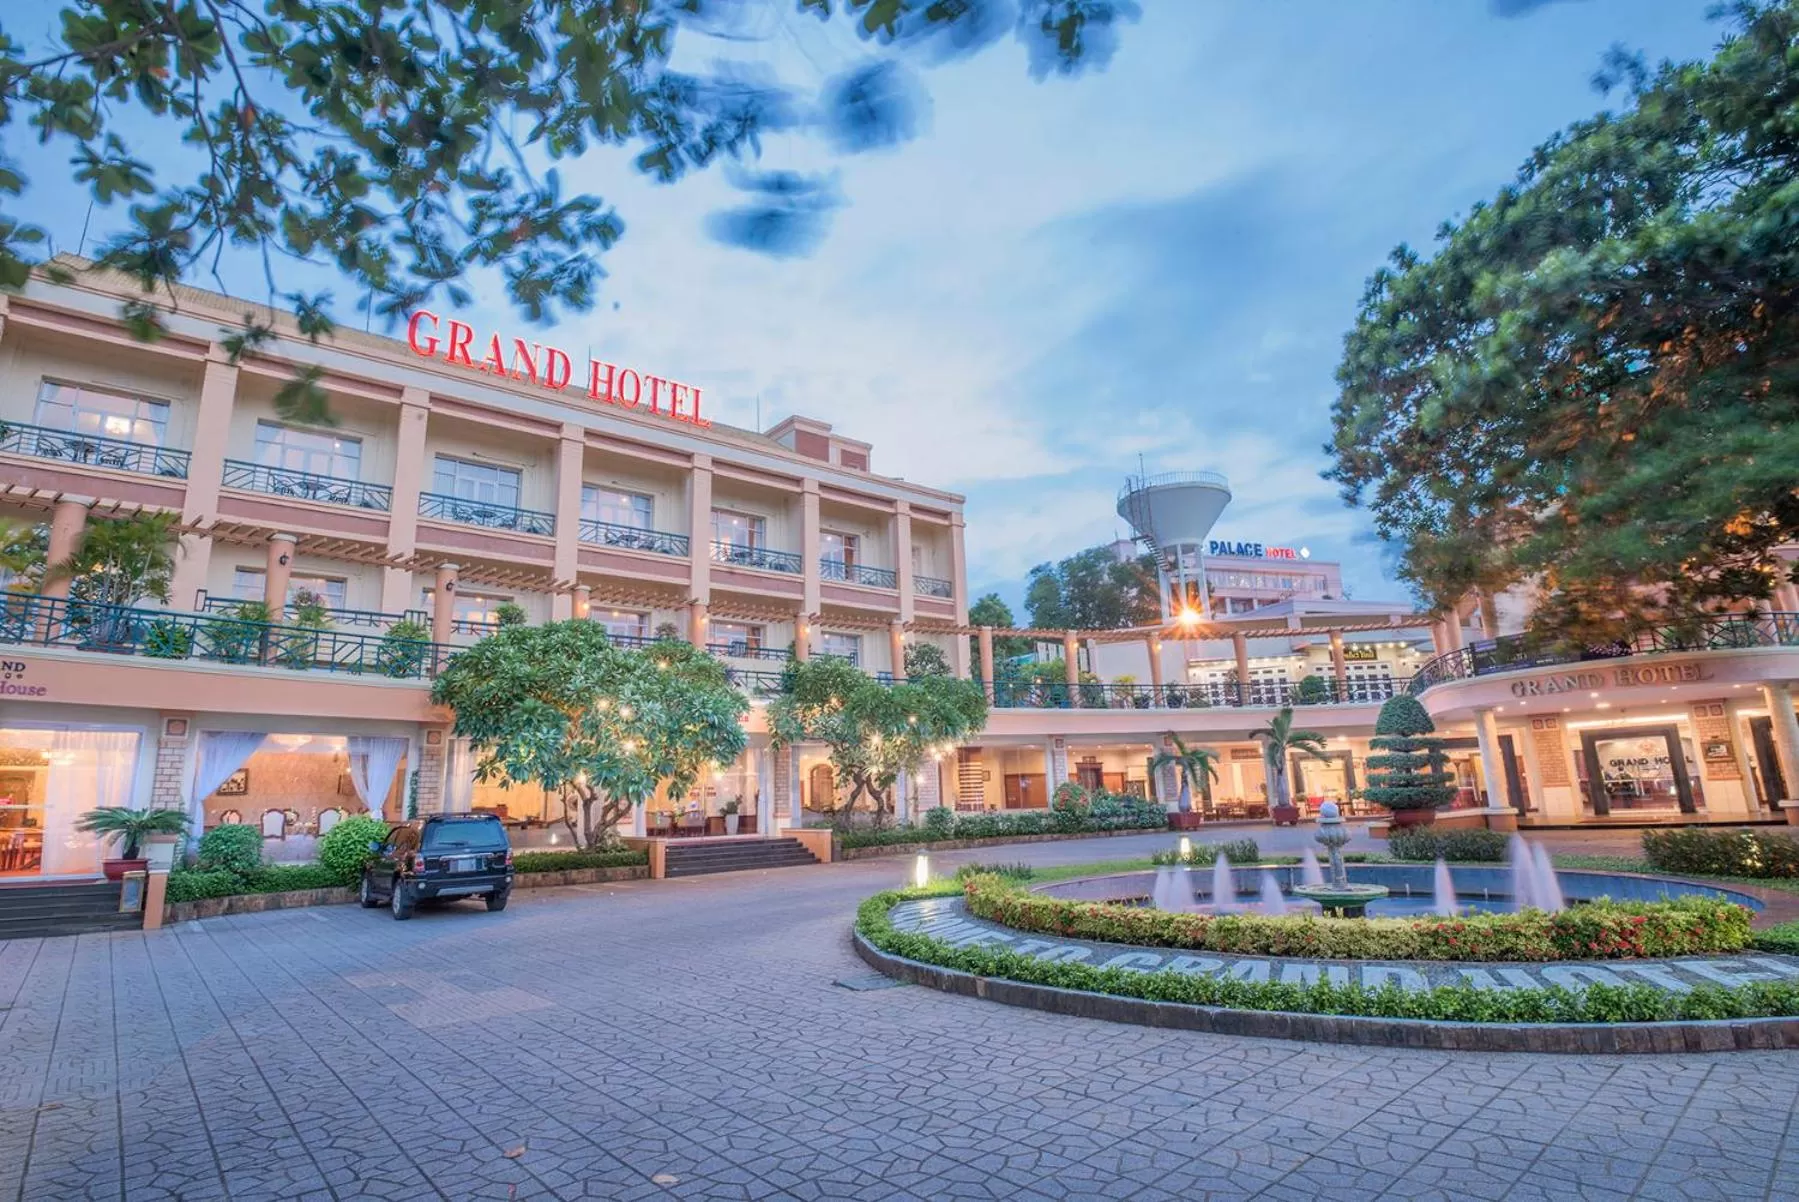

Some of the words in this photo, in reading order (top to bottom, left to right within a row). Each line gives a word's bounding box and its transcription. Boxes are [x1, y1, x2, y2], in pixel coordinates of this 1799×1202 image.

[407, 309, 573, 392] GRAND
[587, 358, 712, 429] HOTEL
[1209, 540, 1263, 557] PALACE
[1265, 546, 1297, 559] HOTEL
[1511, 670, 1605, 698] GRAND
[1614, 662, 1715, 688] HOTEL
[1609, 757, 1649, 768] GRAND
